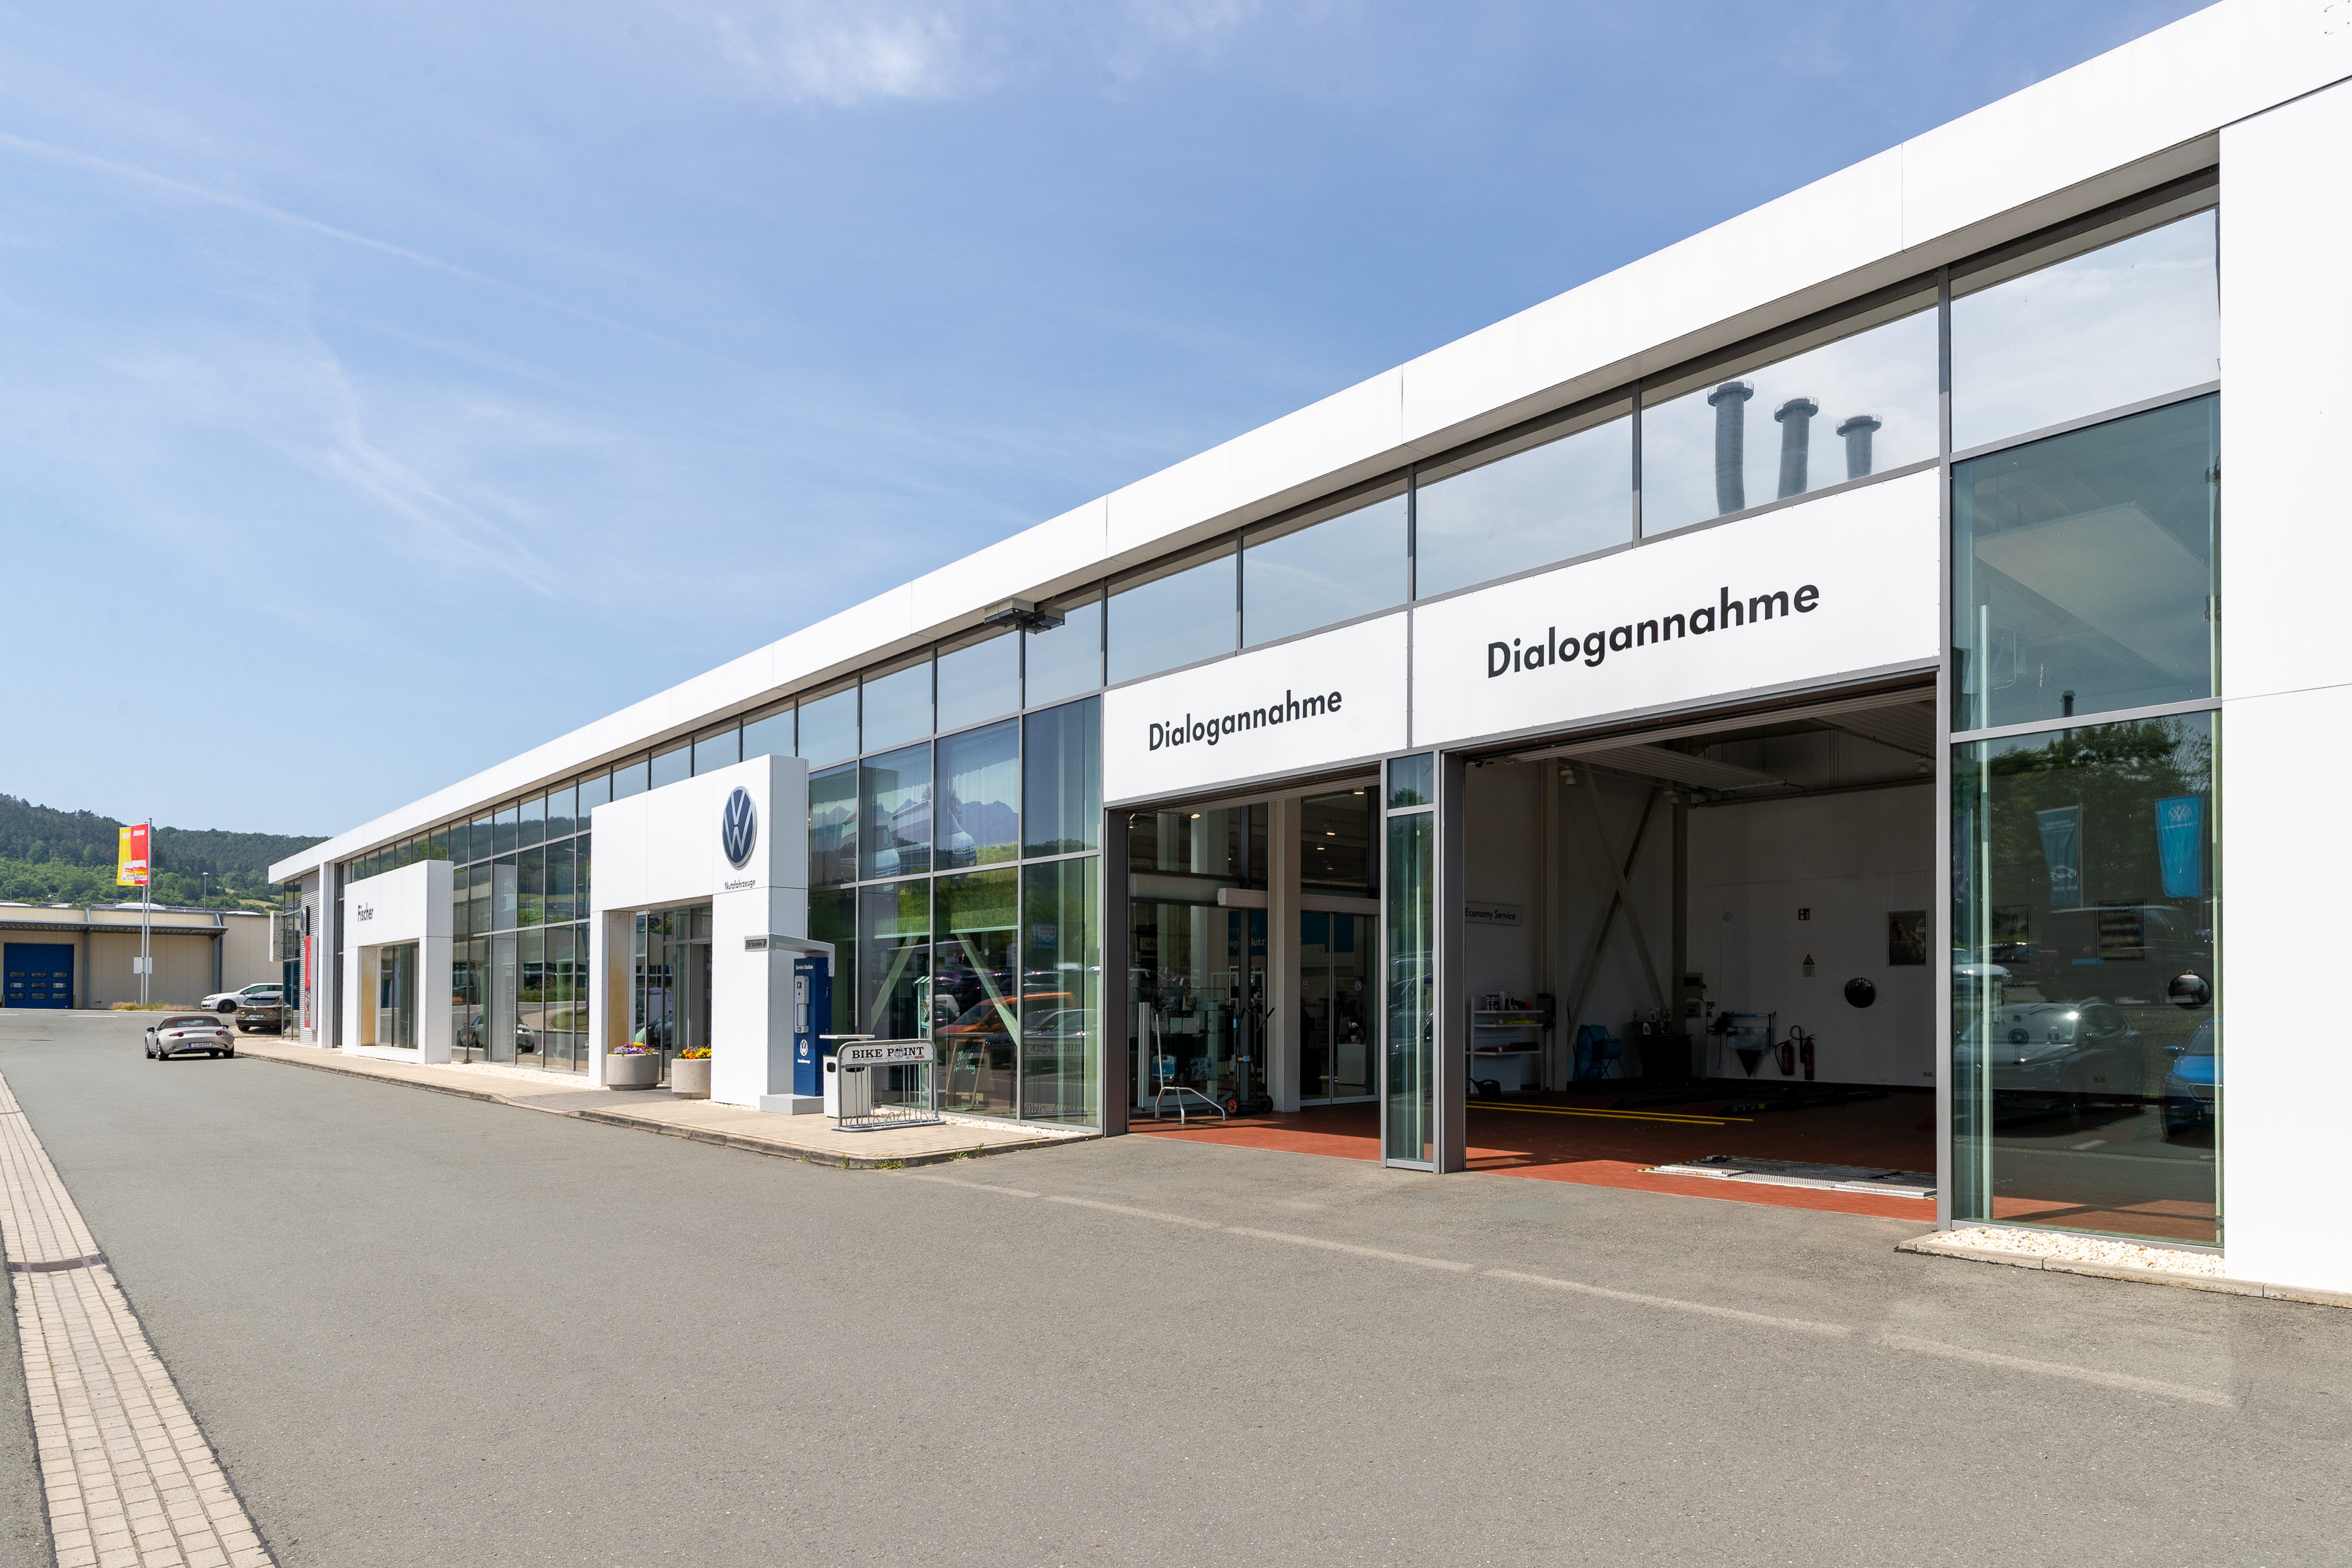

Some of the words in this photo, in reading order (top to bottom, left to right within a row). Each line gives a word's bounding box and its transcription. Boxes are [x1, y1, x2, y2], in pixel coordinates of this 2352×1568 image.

[1488, 584, 1819, 678] Dialogannahme
[1150, 690, 1342, 751] Dialogannahme
[725, 879, 756, 890] Nutzfahrzeuge
[358, 902, 373, 922] Fischer
[1465, 907, 1493, 920] Economy
[1495, 910, 1516, 920] Service
[852, 1049, 883, 1059] BIKE
[887, 1046, 924, 1058] POINT
[958, 1049, 973, 1061] Hallo
